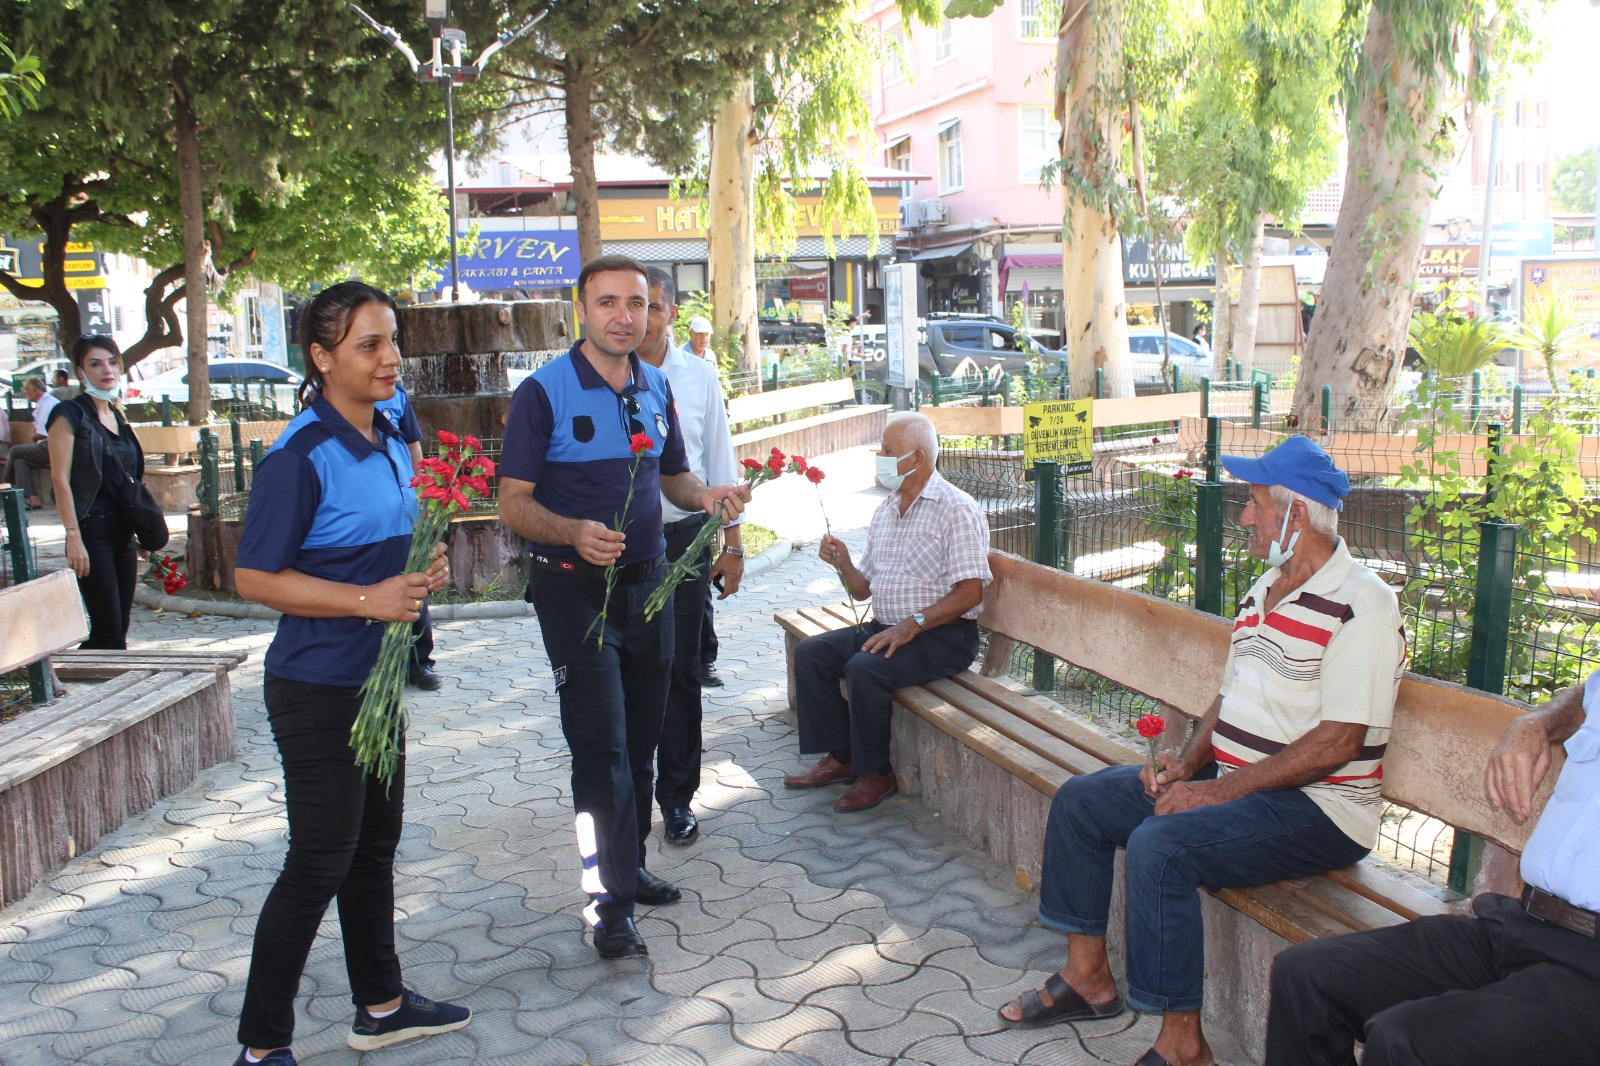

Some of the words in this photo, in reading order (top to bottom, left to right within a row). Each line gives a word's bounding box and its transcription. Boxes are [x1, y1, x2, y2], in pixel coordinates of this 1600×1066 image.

[466, 237, 570, 262] RVEN
[523, 266, 563, 278] ÇANTA
[1043, 403, 1075, 414] PARKIMIZ
[1049, 416, 1063, 425] 7/24
[1060, 426, 1082, 435] KAMERA
